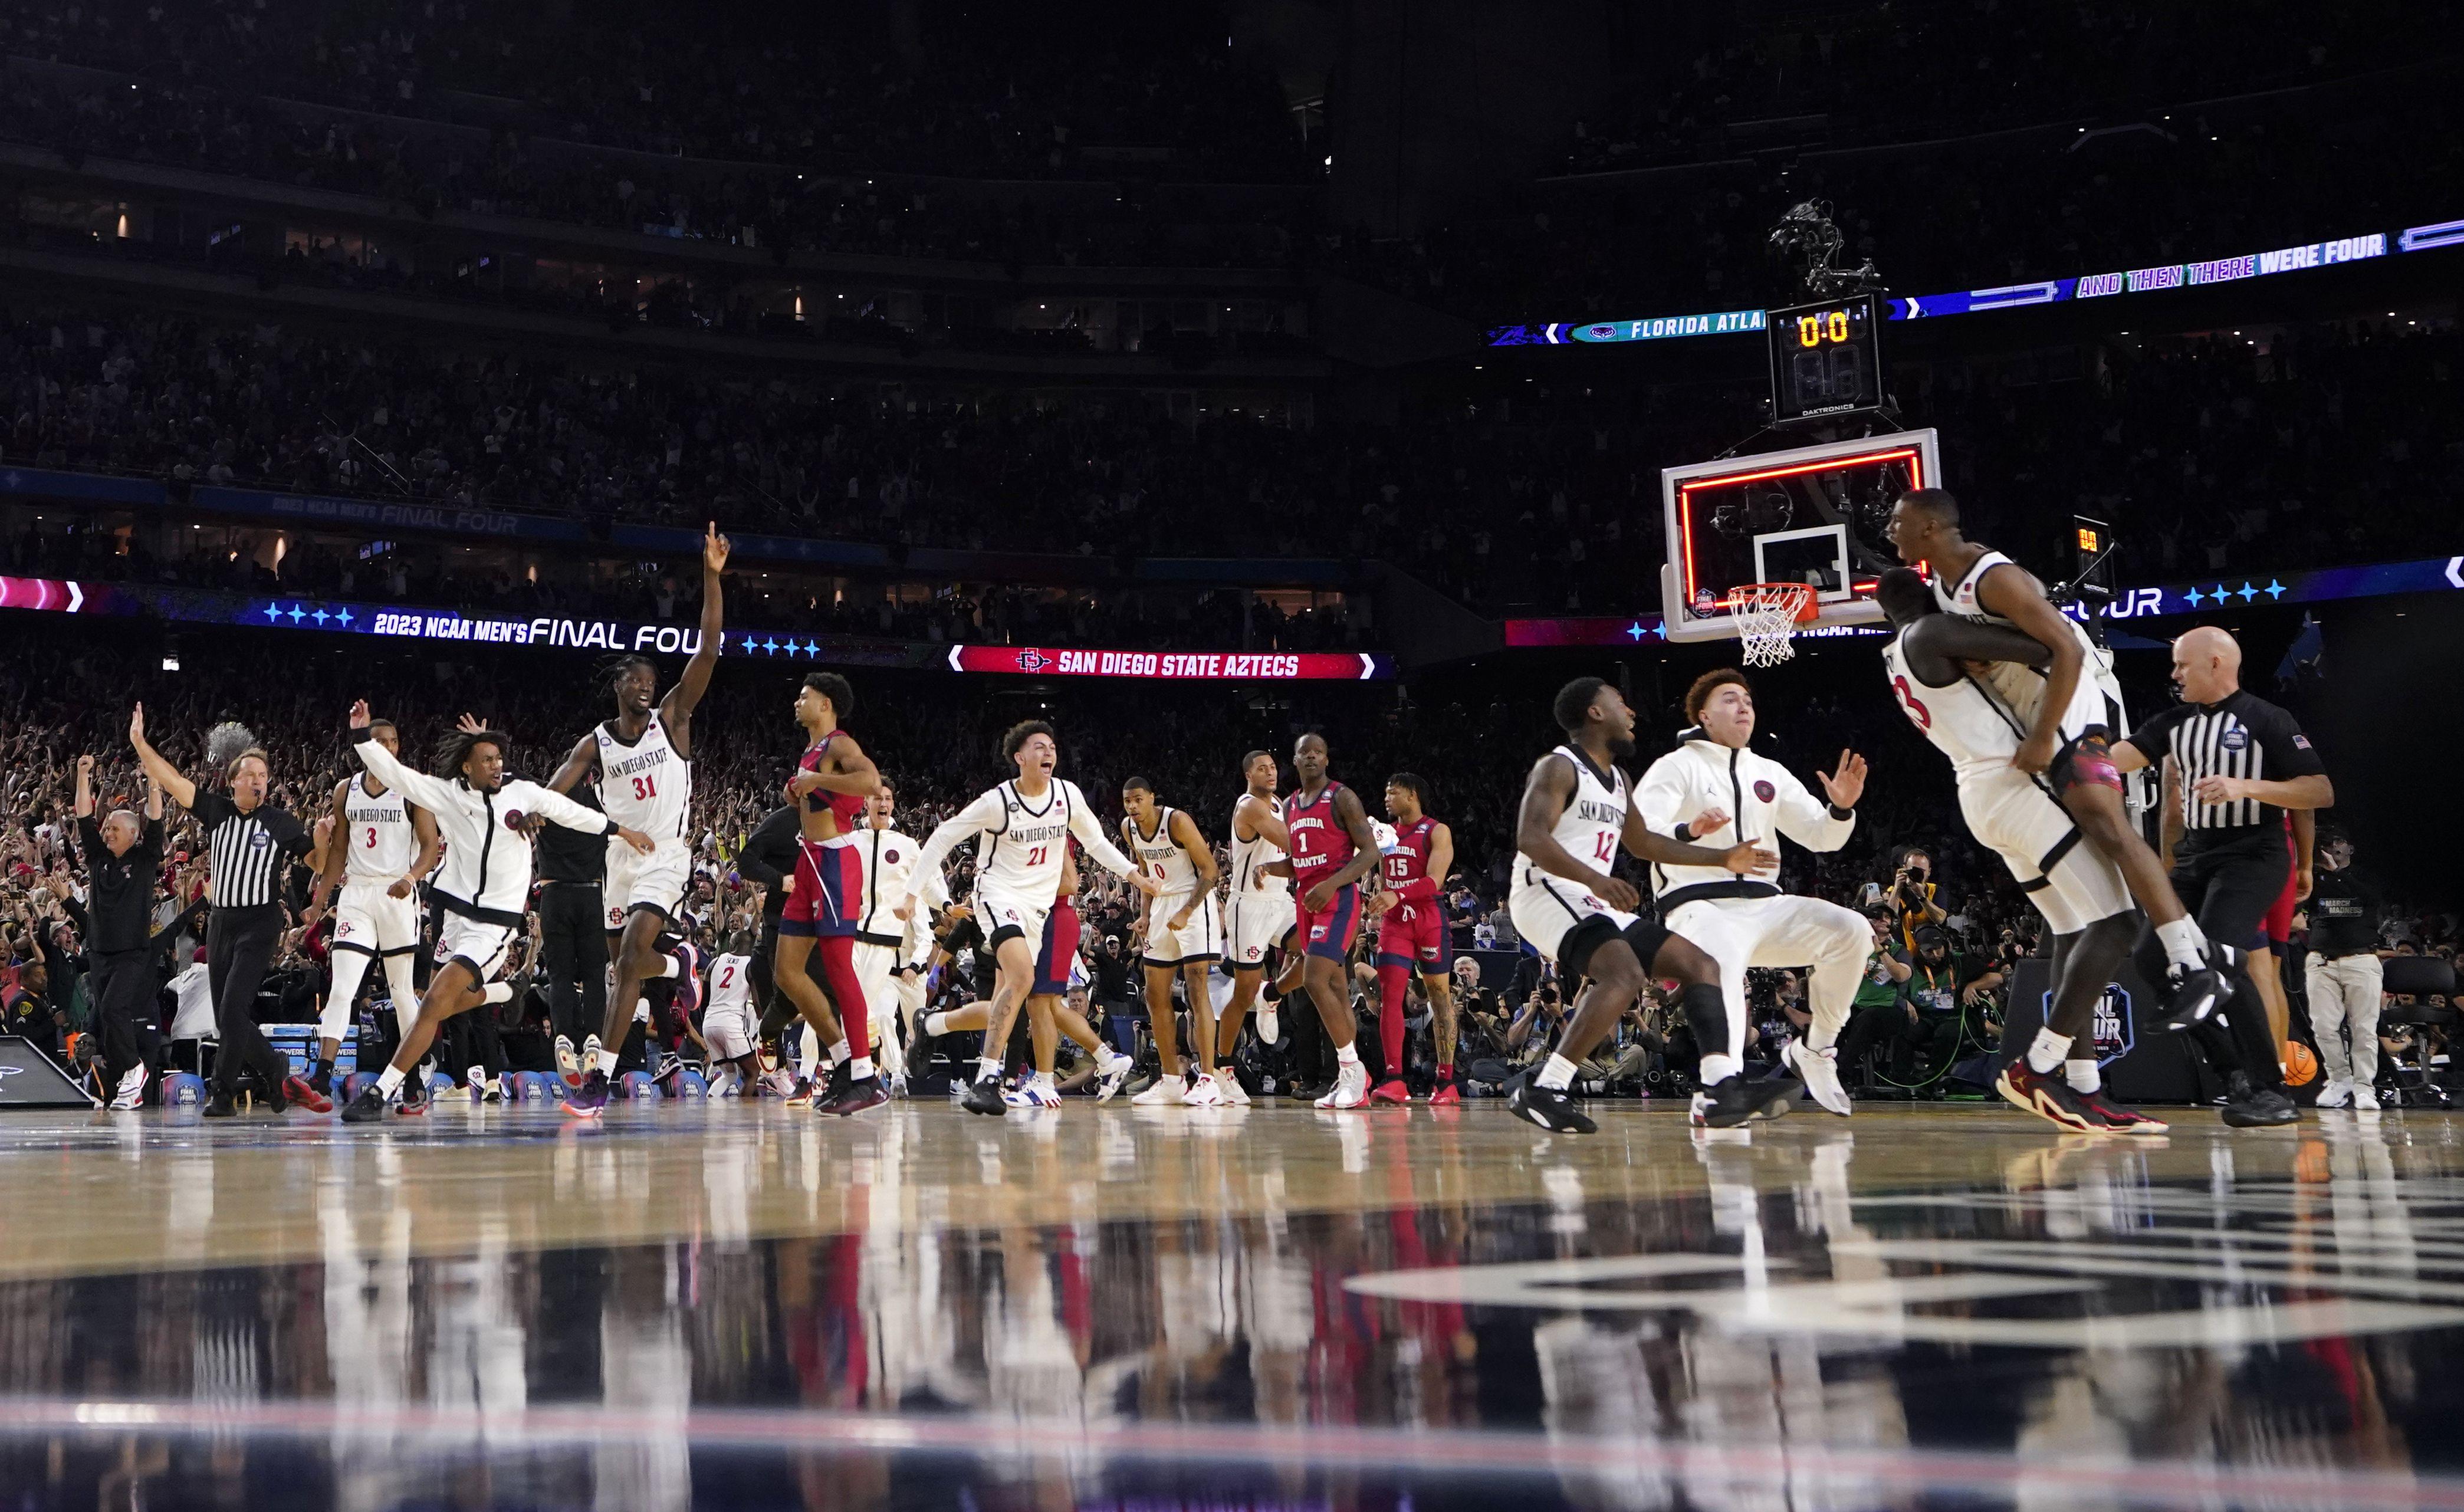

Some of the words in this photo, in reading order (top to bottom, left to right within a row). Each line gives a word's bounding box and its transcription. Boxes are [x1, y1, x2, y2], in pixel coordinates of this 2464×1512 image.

[2077, 272, 2121, 298] AND
[2127, 265, 2182, 292] THEN
[2187, 255, 2255, 285] THERE
[2259, 244, 2320, 274] WERE
[2324, 234, 2384, 264] FOUR
[1631, 314, 1709, 338] FLORIDA
[1716, 311, 1766, 331] ATLA
[1802, 403, 1854, 416] DAKTRONICS
[382, 505, 449, 528] FINAL
[455, 512, 518, 533] FOUR
[374, 614, 421, 636] 2023
[425, 617, 471, 639] NCAA
[473, 622, 527, 643] MEN'S
[528, 618, 625, 650] FINAL
[635, 626, 702, 654] FOU
[1059, 651, 1098, 673] SAN
[1102, 653, 1157, 675] DIEGO
[1161, 655, 1220, 676] STATE
[1224, 655, 1298, 678] AZTECS
[608, 764, 623, 778] SAN
[622, 755, 646, 775] DIEGO
[645, 747, 667, 768] STATE
[632, 774, 656, 800] 31
[347, 809, 358, 822] SAN
[359, 808, 379, 822] DIEGO
[380, 809, 402, 823] STATE
[1578, 800, 1596, 821] SAN
[1010, 830, 1024, 843] SAN
[1026, 827, 1047, 842] DIEGO
[1290, 817, 1325, 834] FLORIDA
[366, 827, 376, 849] 3
[1299, 833, 1307, 853] 1
[1594, 831, 1615, 863] 12
[1027, 845, 1047, 866] 21
[1158, 847, 1177, 860] STATE
[1154, 863, 1165, 879] 0
[1389, 859, 1408, 876] 15
[719, 967, 734, 988] 2
[2093, 1018, 2121, 1040] UR
